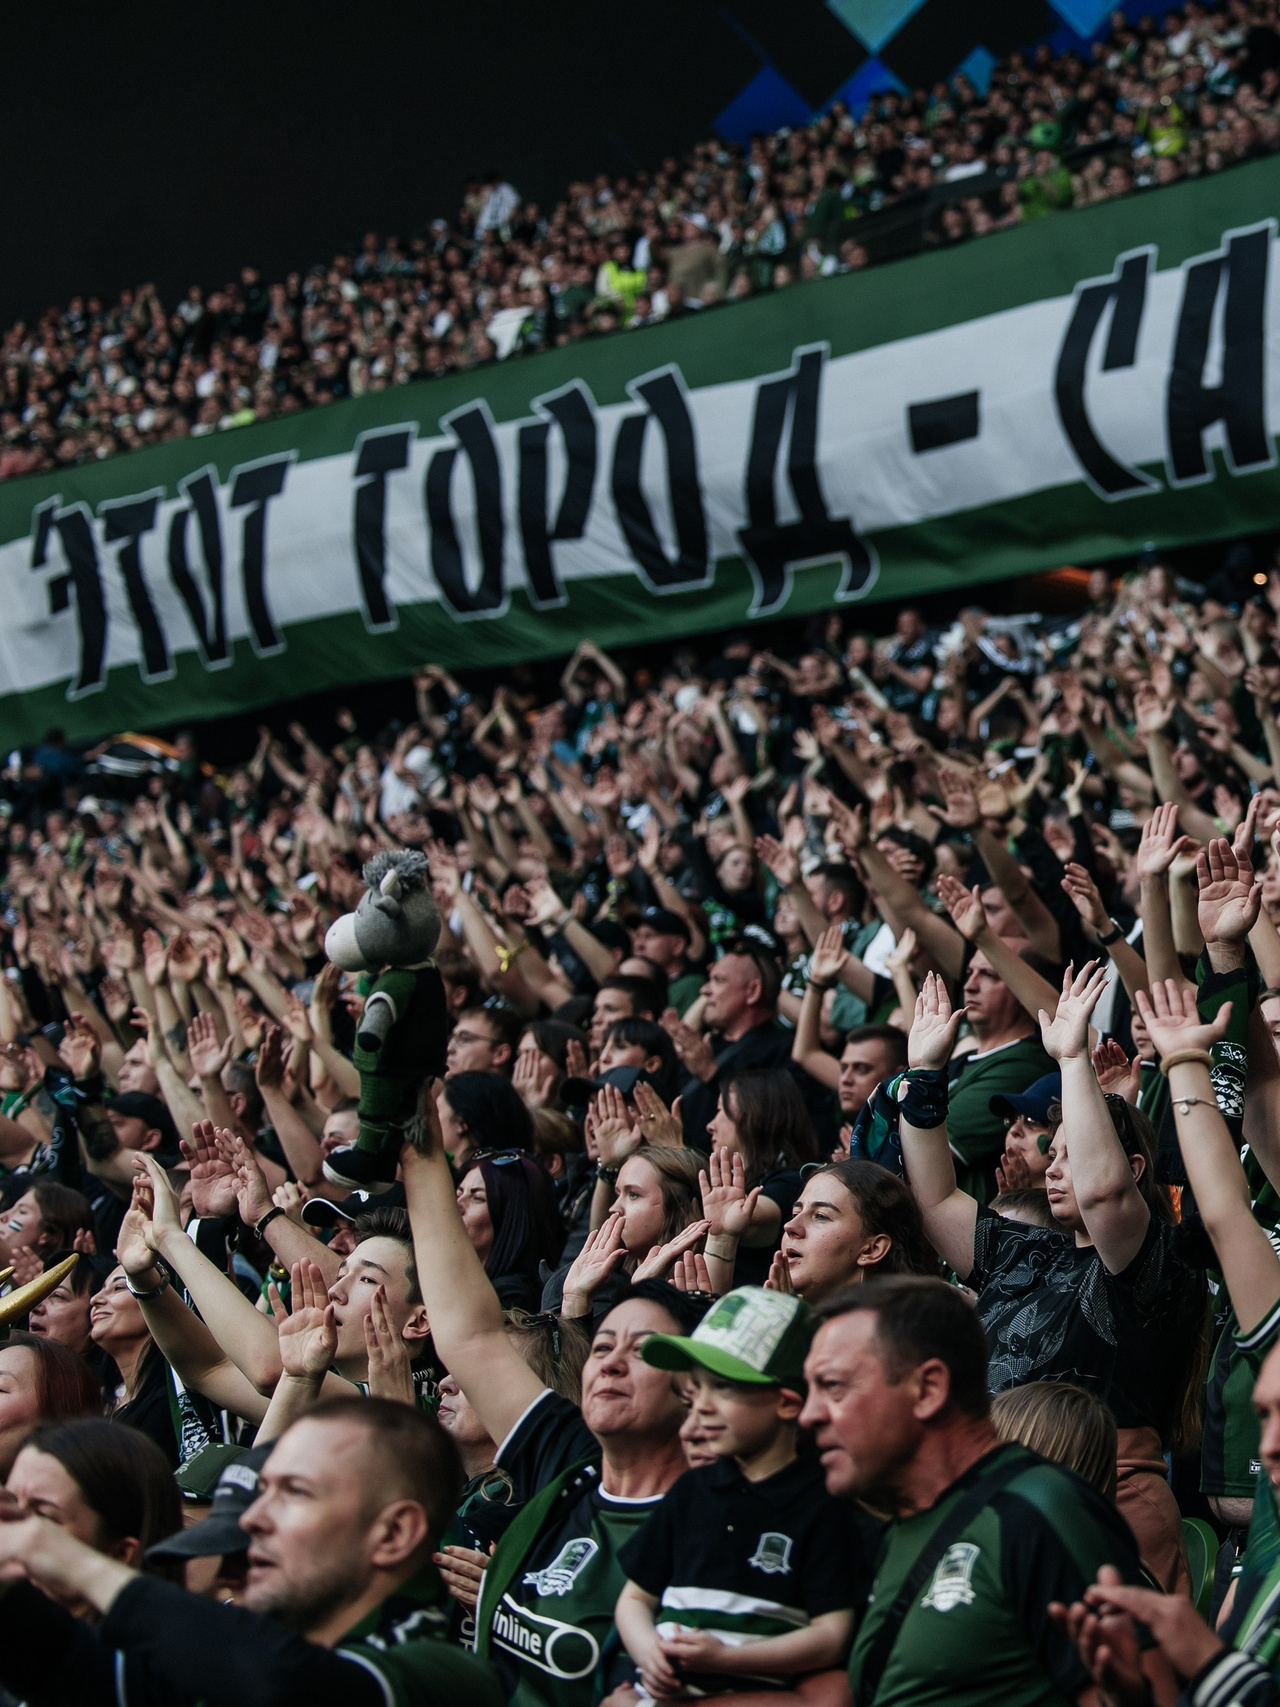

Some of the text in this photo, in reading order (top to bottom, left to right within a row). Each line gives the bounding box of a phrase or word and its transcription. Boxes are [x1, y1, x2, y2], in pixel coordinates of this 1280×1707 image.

[30, 449, 299, 702] ЭТОТ
[352, 341, 880, 619] ГОРОД
[492, 1604, 543, 1656] inline
